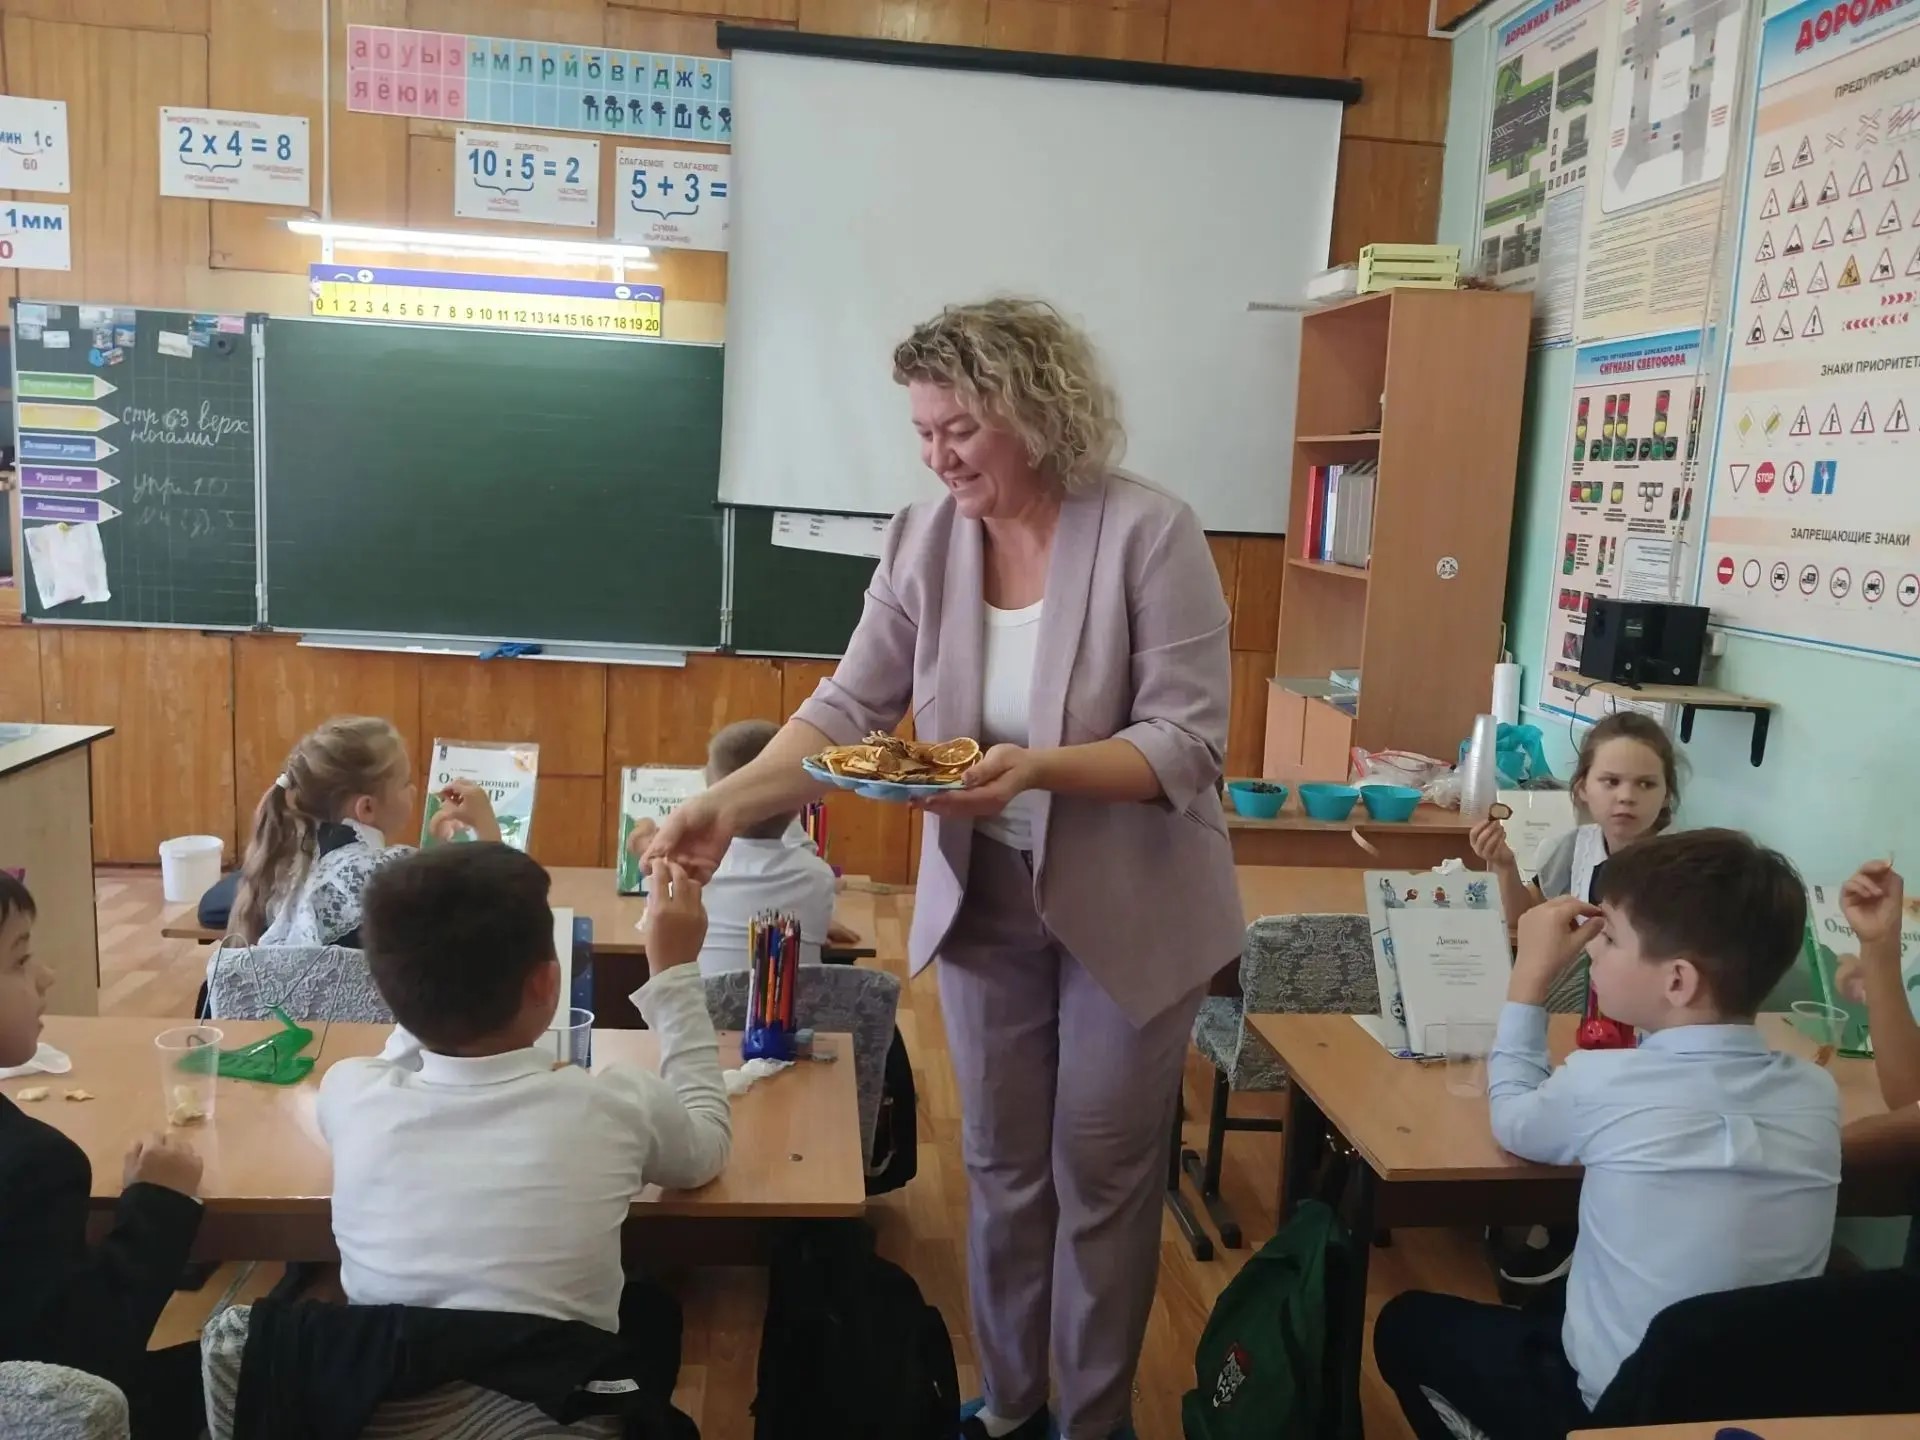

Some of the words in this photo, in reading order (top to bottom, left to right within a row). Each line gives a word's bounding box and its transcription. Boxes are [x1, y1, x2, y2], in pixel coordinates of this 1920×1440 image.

[1795, 0, 1913, 55] ДОРОЖ
[355, 40, 367, 57] а
[377, 44, 390, 60] о
[401, 45, 414, 66] у
[421, 45, 441, 64] ы
[449, 48, 461, 64] э
[473, 52, 485, 67] н
[494, 53, 510, 69] м
[518, 55, 532, 73] л
[542, 57, 555, 80] р
[565, 54, 578, 77] й
[588, 55, 601, 79] б
[611, 64, 624, 81] в
[635, 66, 646, 83] г
[654, 68, 670, 89] д
[677, 70, 693, 88] ж
[701, 71, 713, 89] з
[1834, 56, 1920, 98] ПРЕДУПРЕЖДА
[354, 81, 368, 98] я
[378, 77, 391, 99] ё
[398, 84, 417, 103] ю
[425, 88, 438, 105] и
[448, 90, 461, 107] е
[179, 126, 193, 153] 2
[226, 130, 242, 156] 4
[251, 138, 267, 152] =
[276, 134, 291, 161] 8
[23, 158, 38, 170] 60
[468, 149, 497, 176] 10
[521, 154, 534, 180] 5
[543, 161, 556, 176] =
[565, 157, 580, 183] 2
[619, 157, 664, 168] СЛАГАЕМОЕ
[674, 161, 719, 172] СЛАГАЕМОЕ
[632, 170, 647, 198] 5
[658, 176, 674, 196] +
[685, 174, 700, 202] 3
[711, 183, 727, 198] =
[316, 299, 324, 311] 0
[334, 299, 339, 312] 1
[349, 300, 357, 313] 2
[366, 301, 373, 313] 3
[382, 302, 390, 314] 4
[400, 303, 407, 316] 5
[417, 304, 424, 317] 6
[433, 305, 440, 317] 7
[449, 306, 457, 319] 8
[466, 307, 474, 319] 9
[480, 308, 493, 320] 10
[498, 309, 510, 321] 11
[514, 310, 527, 322] 12
[531, 311, 544, 323] 13
[547, 312, 560, 325] 14
[564, 313, 577, 326] 15
[581, 314, 594, 327] 16
[598, 315, 611, 328] 17
[614, 316, 627, 329] 18
[630, 317, 643, 330] 19
[645, 318, 659, 331] 20
[1599, 359, 1634, 375] СИГНАЛЫ
[1637, 353, 1687, 371] СВЕТОФОРА
[1821, 362, 1853, 377] ЗНАКИ
[1856, 355, 1920, 373] ПРИОРИТЕТ
[1756, 472, 1775, 484] STOP
[1791, 527, 1872, 544] ЗАПРЕЩАЮЩИЕ
[1874, 532, 1911, 546] ЗНАКИ
